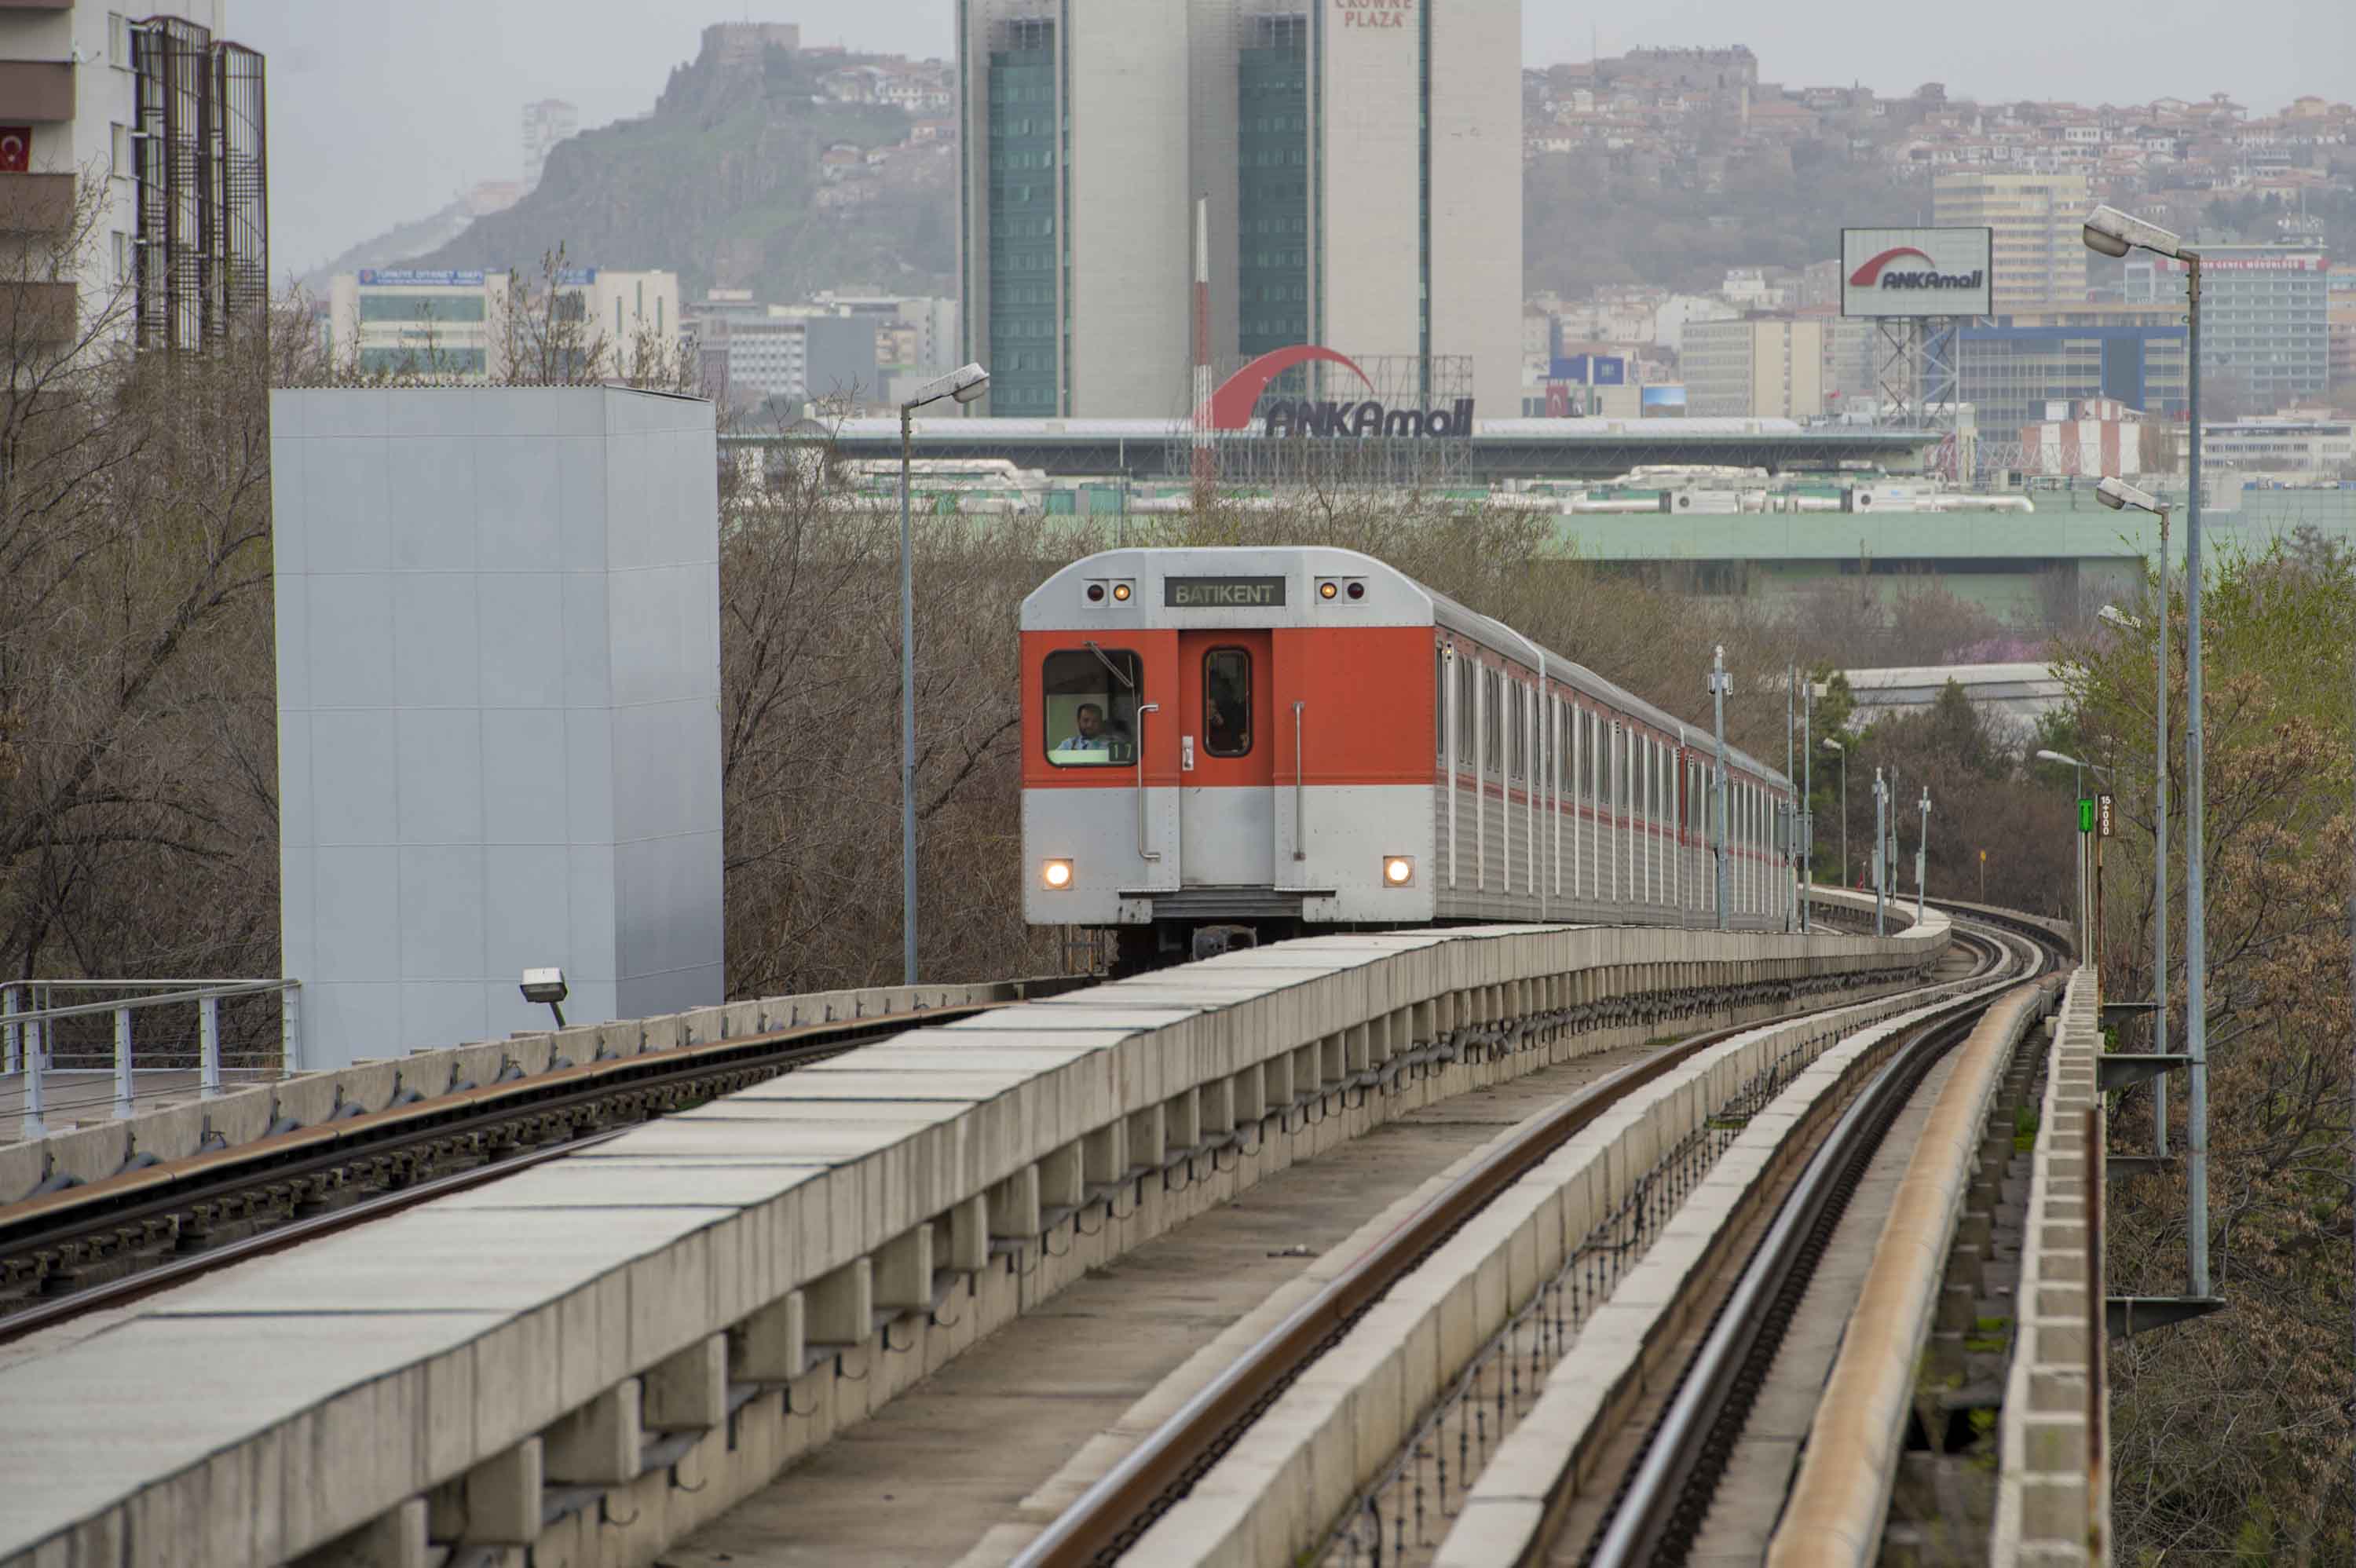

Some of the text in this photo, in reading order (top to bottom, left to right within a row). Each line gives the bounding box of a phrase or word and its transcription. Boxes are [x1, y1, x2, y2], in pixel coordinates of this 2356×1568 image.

[1344, 11, 1403, 27] PLAZA
[1882, 270, 1983, 289] ANKAmall
[1265, 398, 1475, 437] ANKAmall
[1176, 585, 1275, 603] BATIKENT
[1114, 744, 1132, 760] 17
